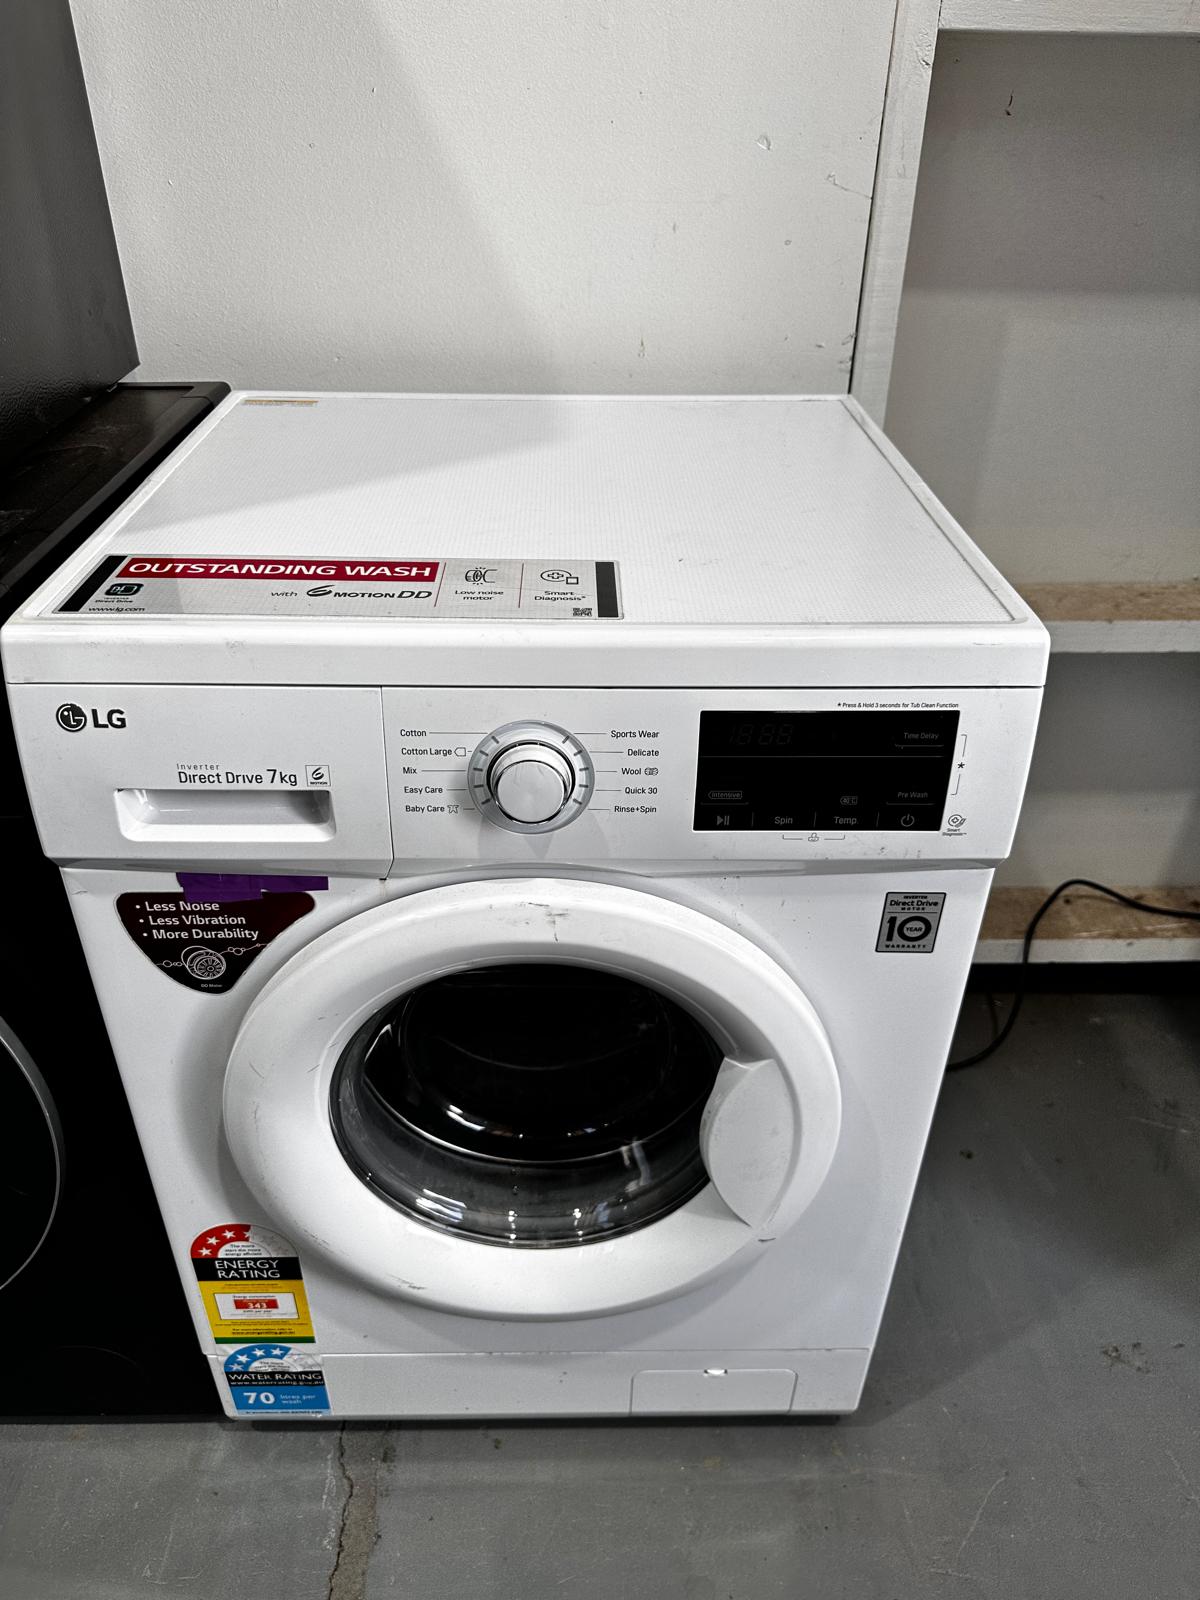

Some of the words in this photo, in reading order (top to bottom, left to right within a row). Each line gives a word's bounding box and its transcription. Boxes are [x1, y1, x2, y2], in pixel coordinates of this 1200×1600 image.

[129, 562, 338, 576] OUTSTANDING
[345, 566, 431, 577] WASH
[396, 590, 432, 599] DD
[91, 708, 127, 729] LG
[400, 729, 427, 737] Cotton
[611, 730, 637, 739] Sports
[638, 730, 660, 738] Wear
[920, 732, 939, 740] Delay
[401, 747, 429, 756] Cotton
[429, 747, 453, 757] Large
[627, 748, 660, 757] Delicate
[176, 763, 220, 771] Inverter
[402, 766, 418, 775] Mix
[621, 767, 642, 776] Wool
[178, 771, 222, 784] Direct
[225, 771, 264, 784] Drive
[404, 785, 424, 795] Easy
[424, 785, 443, 794] Care
[624, 786, 646, 795] Quick
[647, 786, 658, 795] 30
[897, 791, 909, 799] Pre
[910, 791, 929, 799] Wash
[405, 804, 426, 814] Baby
[426, 804, 445, 813] Care
[614, 805, 657, 814] Rinse+Spin
[774, 816, 793, 826] Spin
[145, 901, 177, 911] Less
[179, 901, 220, 911] Noise
[148, 915, 180, 926] Less
[181, 915, 246, 925] Vibration
[886, 915, 932, 942] 10
[152, 929, 189, 939] More
[192, 928, 259, 941] Durability
[215, 1260, 279, 1269] ENERGY
[217, 1269, 281, 1279] RATING
[243, 1392, 275, 1404] 70
